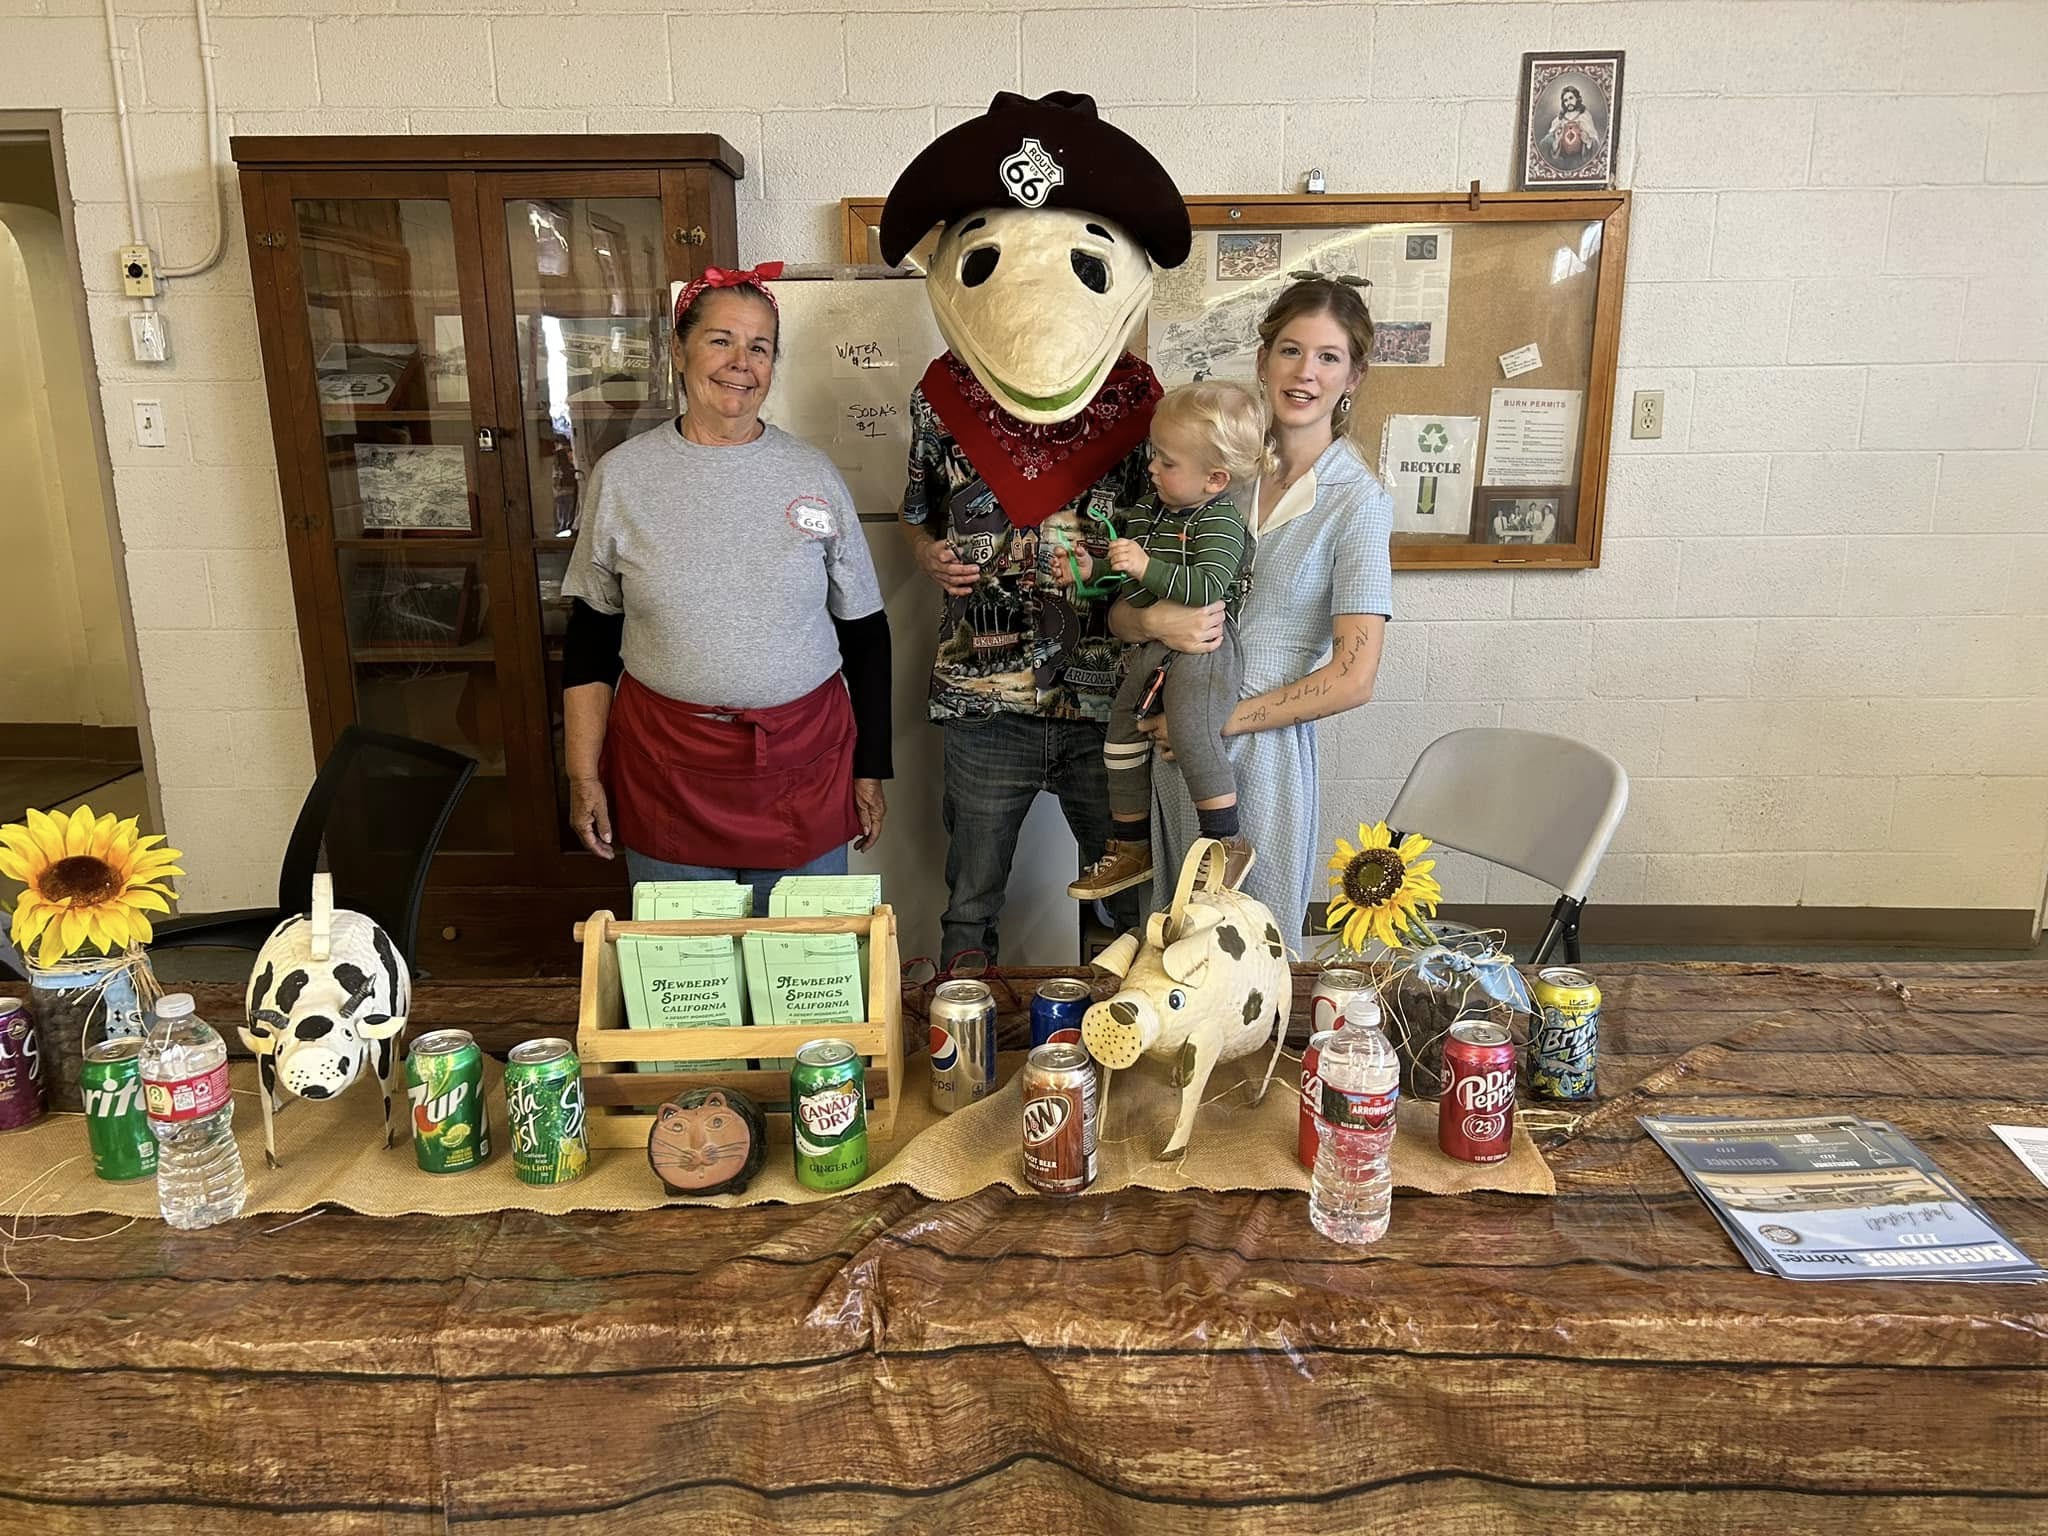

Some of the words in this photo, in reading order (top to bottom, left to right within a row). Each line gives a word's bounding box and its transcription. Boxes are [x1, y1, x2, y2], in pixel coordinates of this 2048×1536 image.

[1028, 147, 1057, 179] ROUTE
[1029, 165, 1039, 177] US
[1006, 160, 1045, 202] 66
[1407, 237, 1437, 258] 66
[835, 341, 883, 360] WATER
[847, 403, 897, 419] SODA'S
[1503, 399, 1527, 408] BURN
[1530, 400, 1567, 409] PERMITS
[1400, 461, 1461, 474] RECYCLE
[803, 517, 825, 530] 66
[973, 547, 990, 561] 66
[1067, 669, 1114, 685] ARIZONA
[652, 976, 729, 992] NEWBERRY
[776, 974, 853, 989] NEWBERRY
[661, 991, 720, 1004] SPRINGS
[785, 989, 843, 1001] SPRINGS
[662, 1002, 727, 1013] CALIFORNIA
[786, 1000, 850, 1010] CALIFORNIA
[1542, 1016, 1598, 1053] Brisk
[932, 1076, 955, 1092] epsi
[1487, 1069, 1512, 1094] Dr
[83, 1077, 146, 1117] rit
[508, 1080, 545, 1121] asta
[800, 1089, 861, 1123] CANADA
[818, 1109, 851, 1131] DRY
[1024, 1099, 1057, 1139] A&W
[1475, 1120, 1492, 1135] 23
[809, 1162, 848, 1175] GINGER
[1038, 1159, 1058, 1169] BEER
[1897, 1232, 1939, 1246] HD
[1777, 1253, 1855, 1266] Homes
[1857, 1244, 2020, 1268] EXCELLENCE
